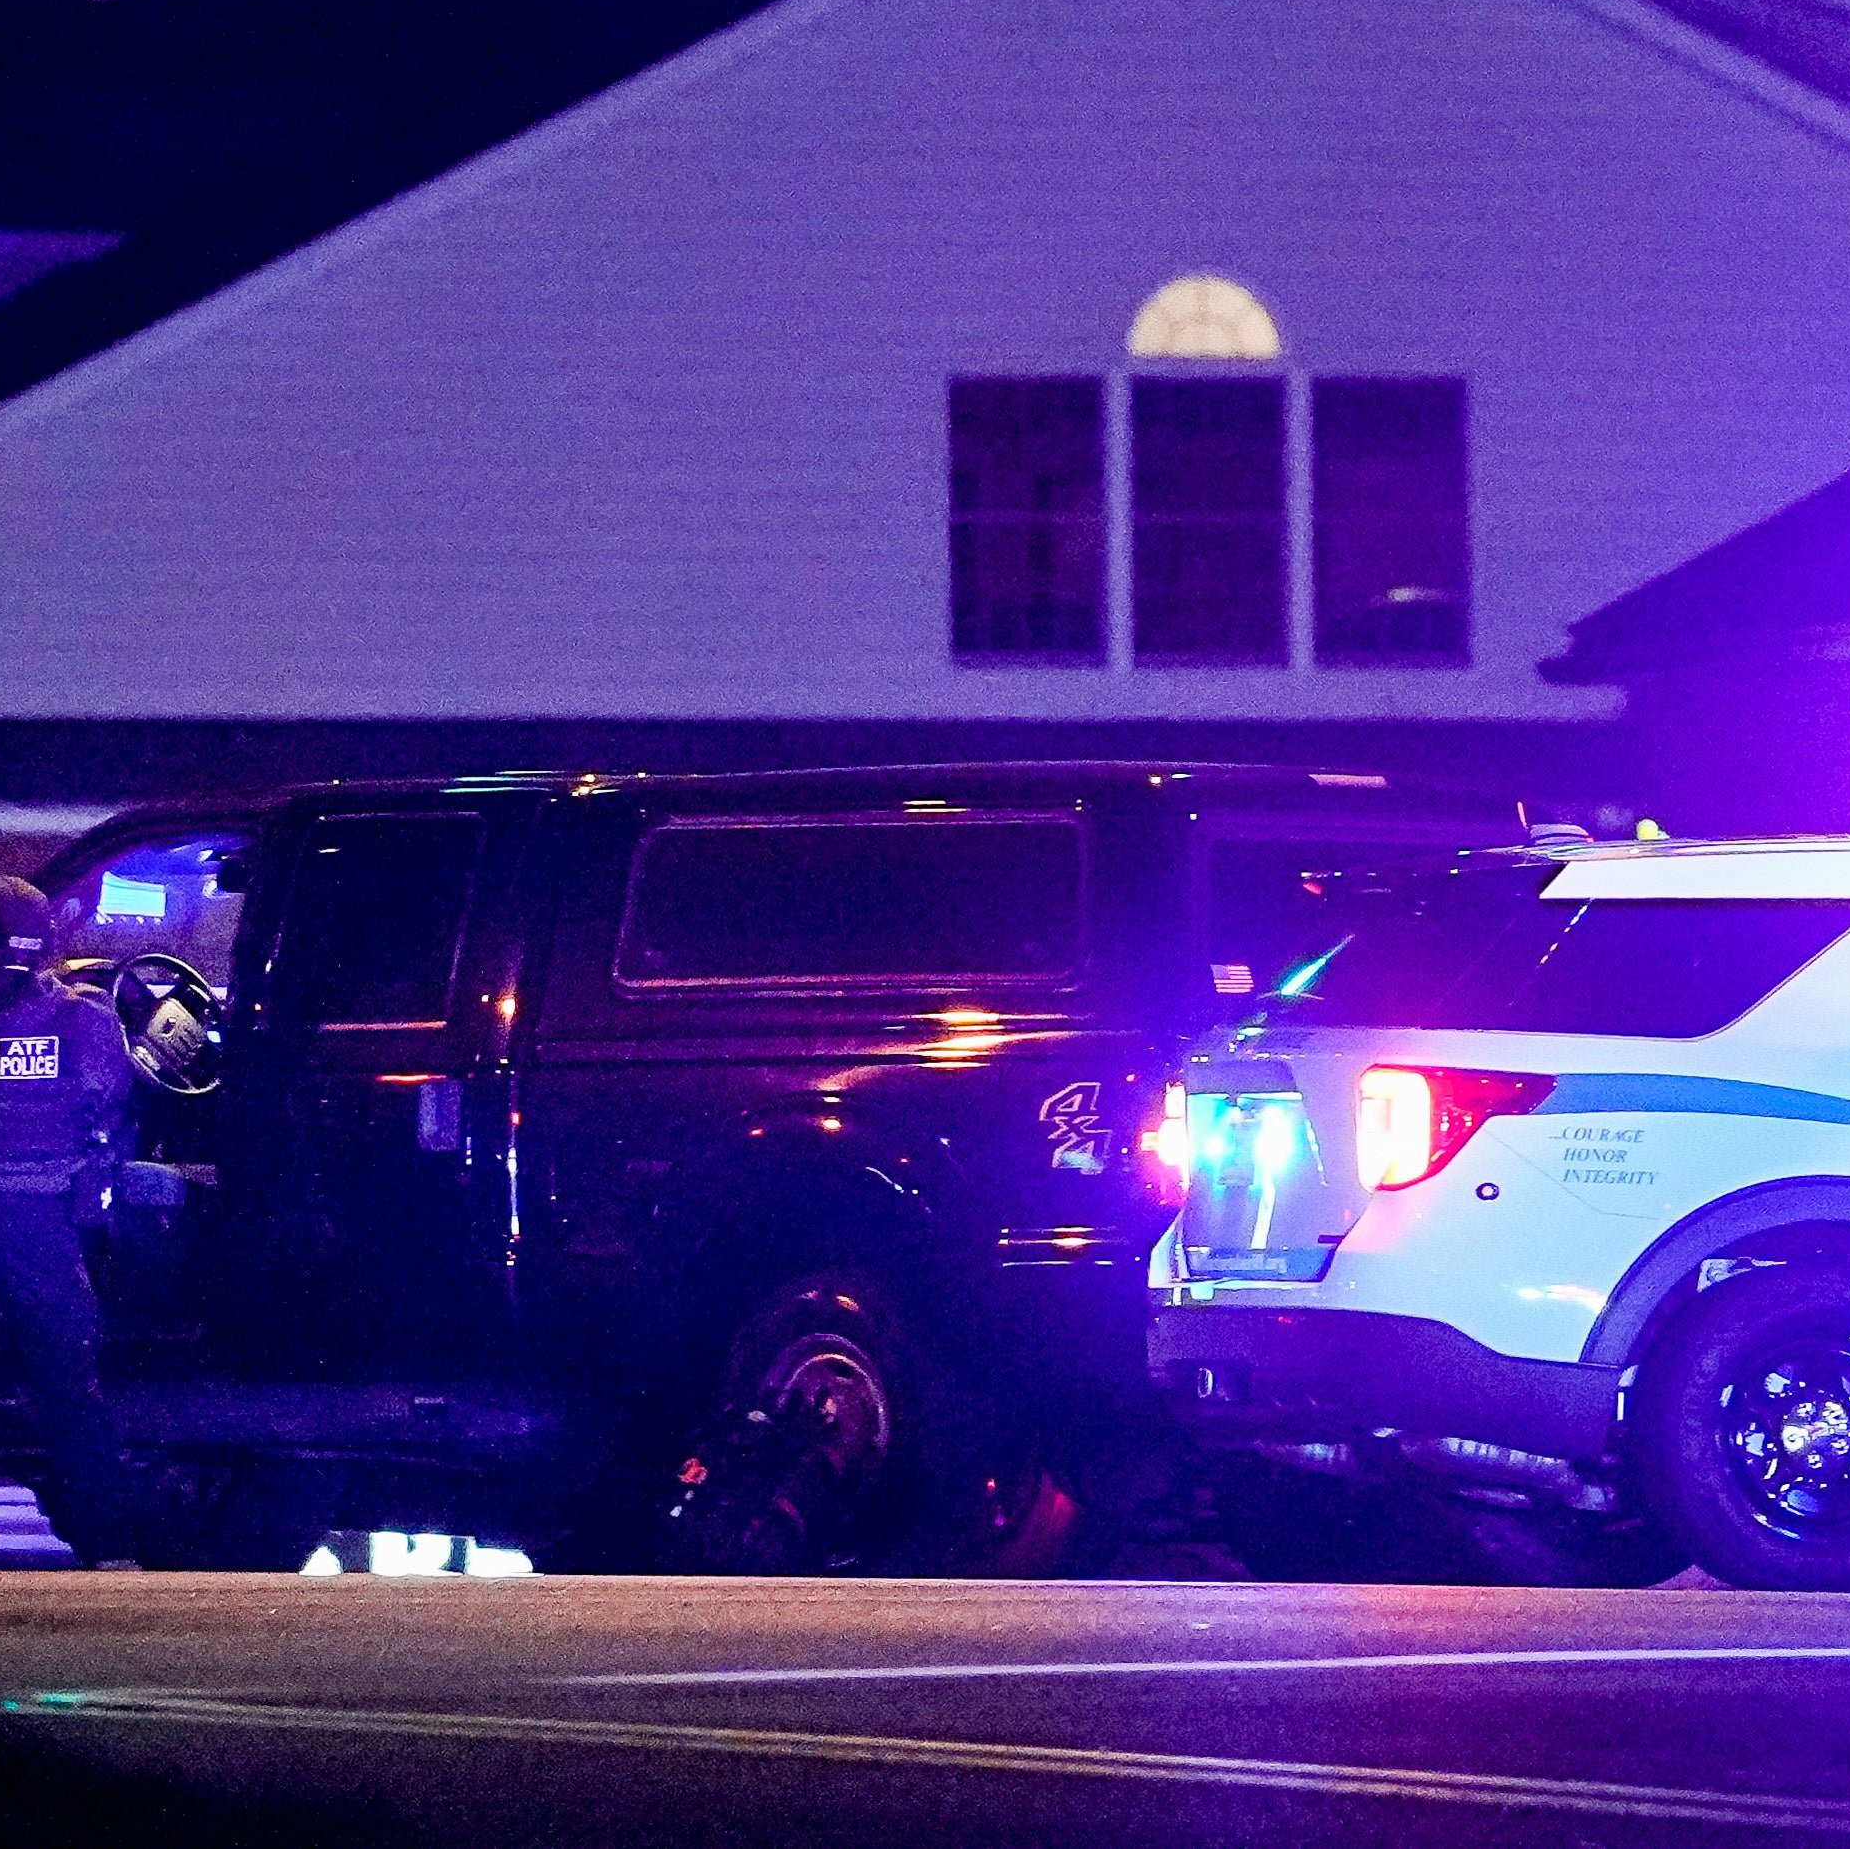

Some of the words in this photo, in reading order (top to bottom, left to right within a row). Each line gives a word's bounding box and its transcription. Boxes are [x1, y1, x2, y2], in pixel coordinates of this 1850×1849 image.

[7, 1040, 49, 1056] ATF
[1, 1056, 56, 1076] POLICE
[1563, 1148, 1628, 1163] HONOR
[1563, 1168, 1659, 1185] INTEGRITY
